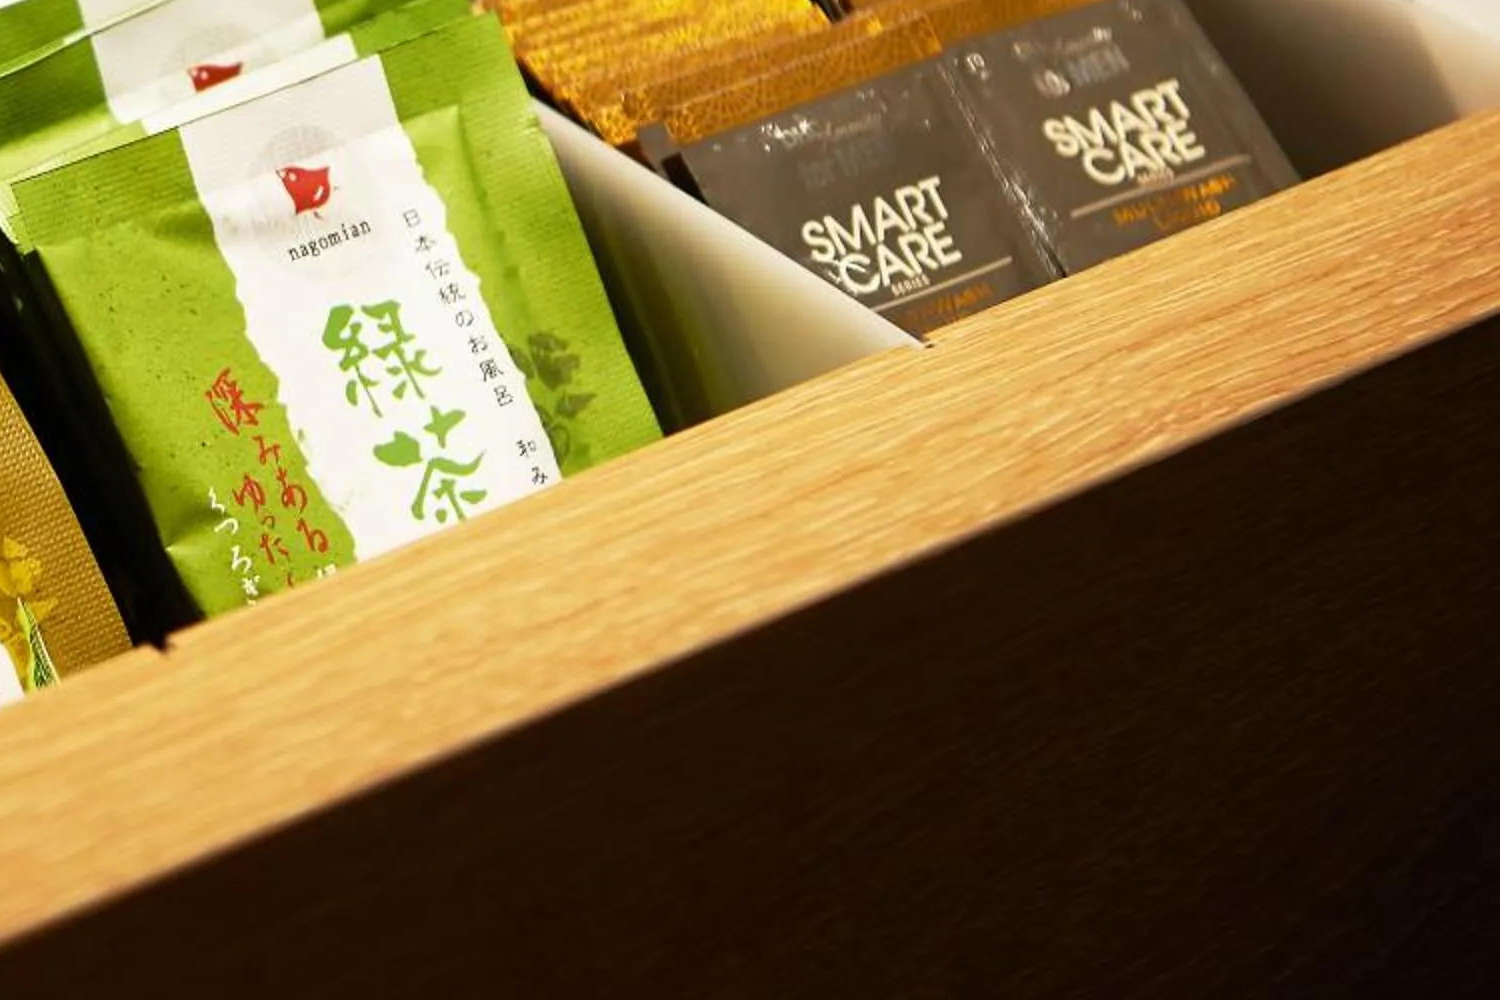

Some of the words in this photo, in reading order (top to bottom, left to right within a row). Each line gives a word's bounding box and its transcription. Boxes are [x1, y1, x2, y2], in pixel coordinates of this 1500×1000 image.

[1042, 77, 1191, 158] SMART
[1081, 118, 1206, 186] CARE
[288, 216, 372, 263] nagomian
[801, 175, 949, 264] SMART
[838, 221, 963, 295] CARE
[403, 209, 514, 408] 日本伝統のお風呂
[321, 299, 489, 524] 緑茶
